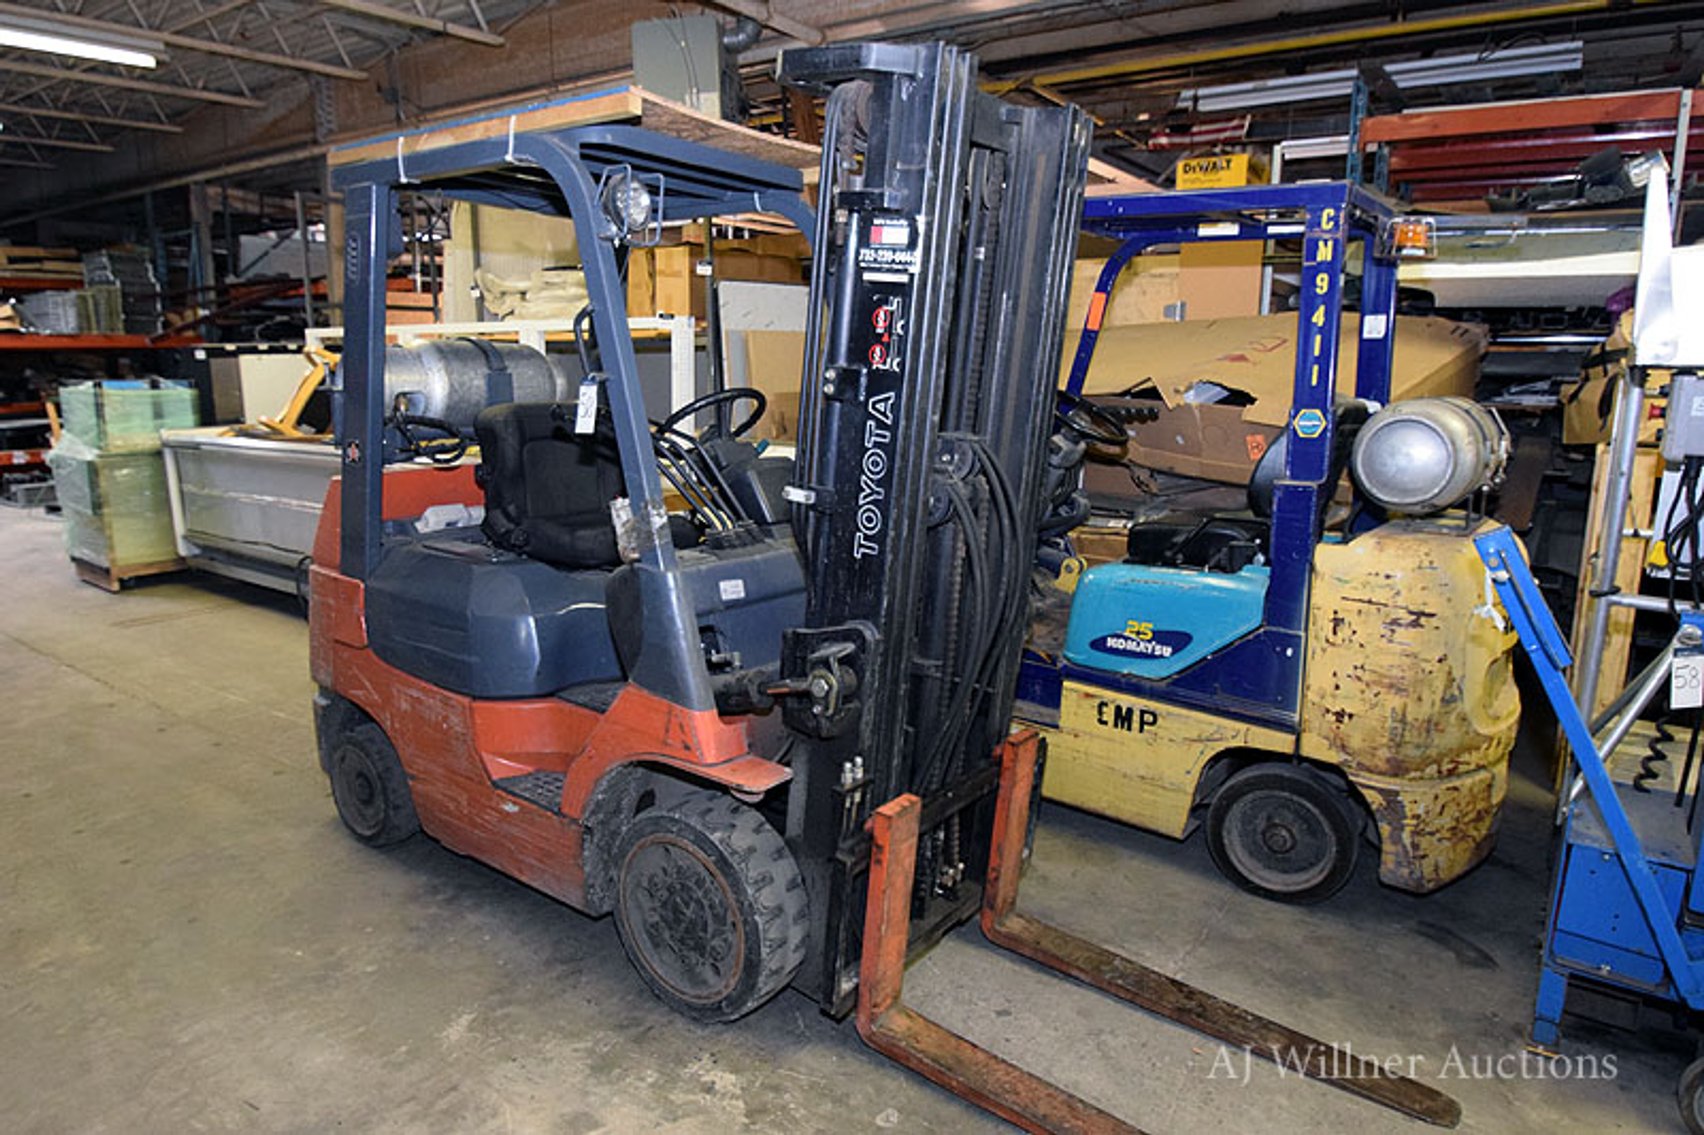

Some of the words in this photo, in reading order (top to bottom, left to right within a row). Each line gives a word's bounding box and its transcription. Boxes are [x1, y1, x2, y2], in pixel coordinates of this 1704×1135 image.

[853, 391, 896, 559] TOYOTA
[1125, 619, 1154, 641] 25
[1106, 636, 1173, 657] KOMATSU
[1096, 700, 1158, 734] CMP
